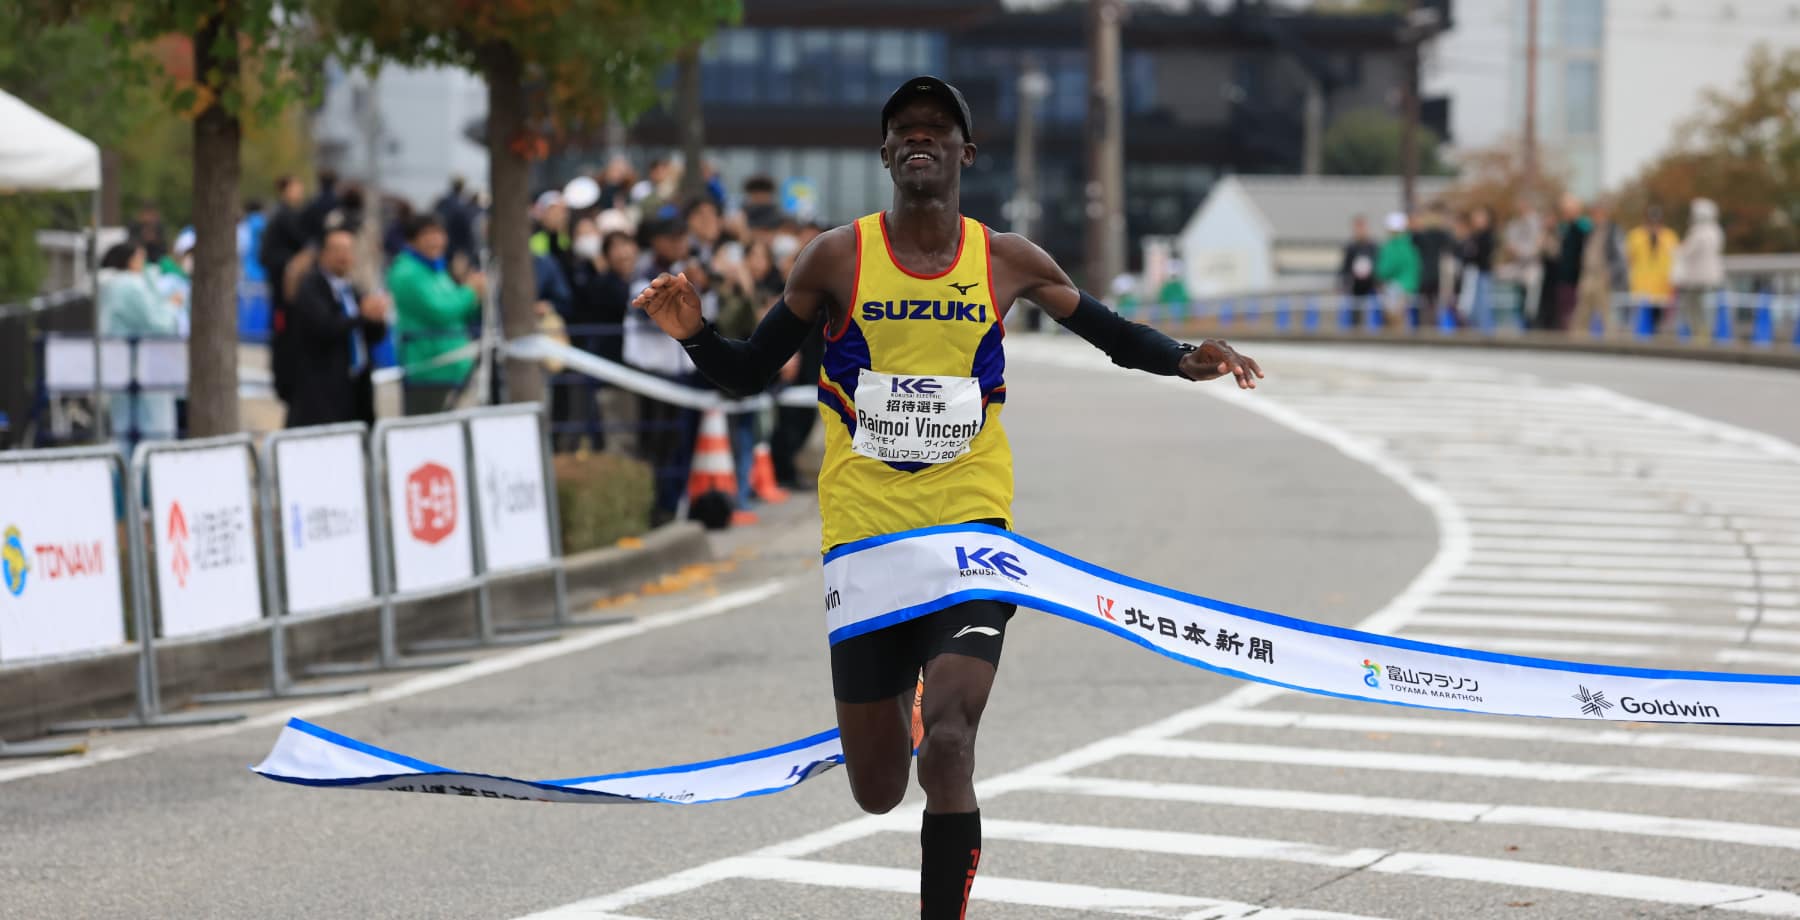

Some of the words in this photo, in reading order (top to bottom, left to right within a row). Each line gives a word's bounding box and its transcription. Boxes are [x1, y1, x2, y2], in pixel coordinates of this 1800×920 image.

[862, 300, 986, 322] SUZUKI
[892, 377, 942, 393] KE
[886, 400, 946, 414] 招待選手
[859, 409, 909, 437] Raimoi
[916, 416, 977, 438] Vincent
[870, 433, 896, 445] ライモイ
[1124, 607, 1274, 664] 北日本新聞
[1386, 665, 1479, 692] 富山マラソン
[1390, 683, 1428, 696] TOYAMA
[1431, 690, 1483, 703] MARATHON
[1620, 696, 1720, 718] Goldwin
